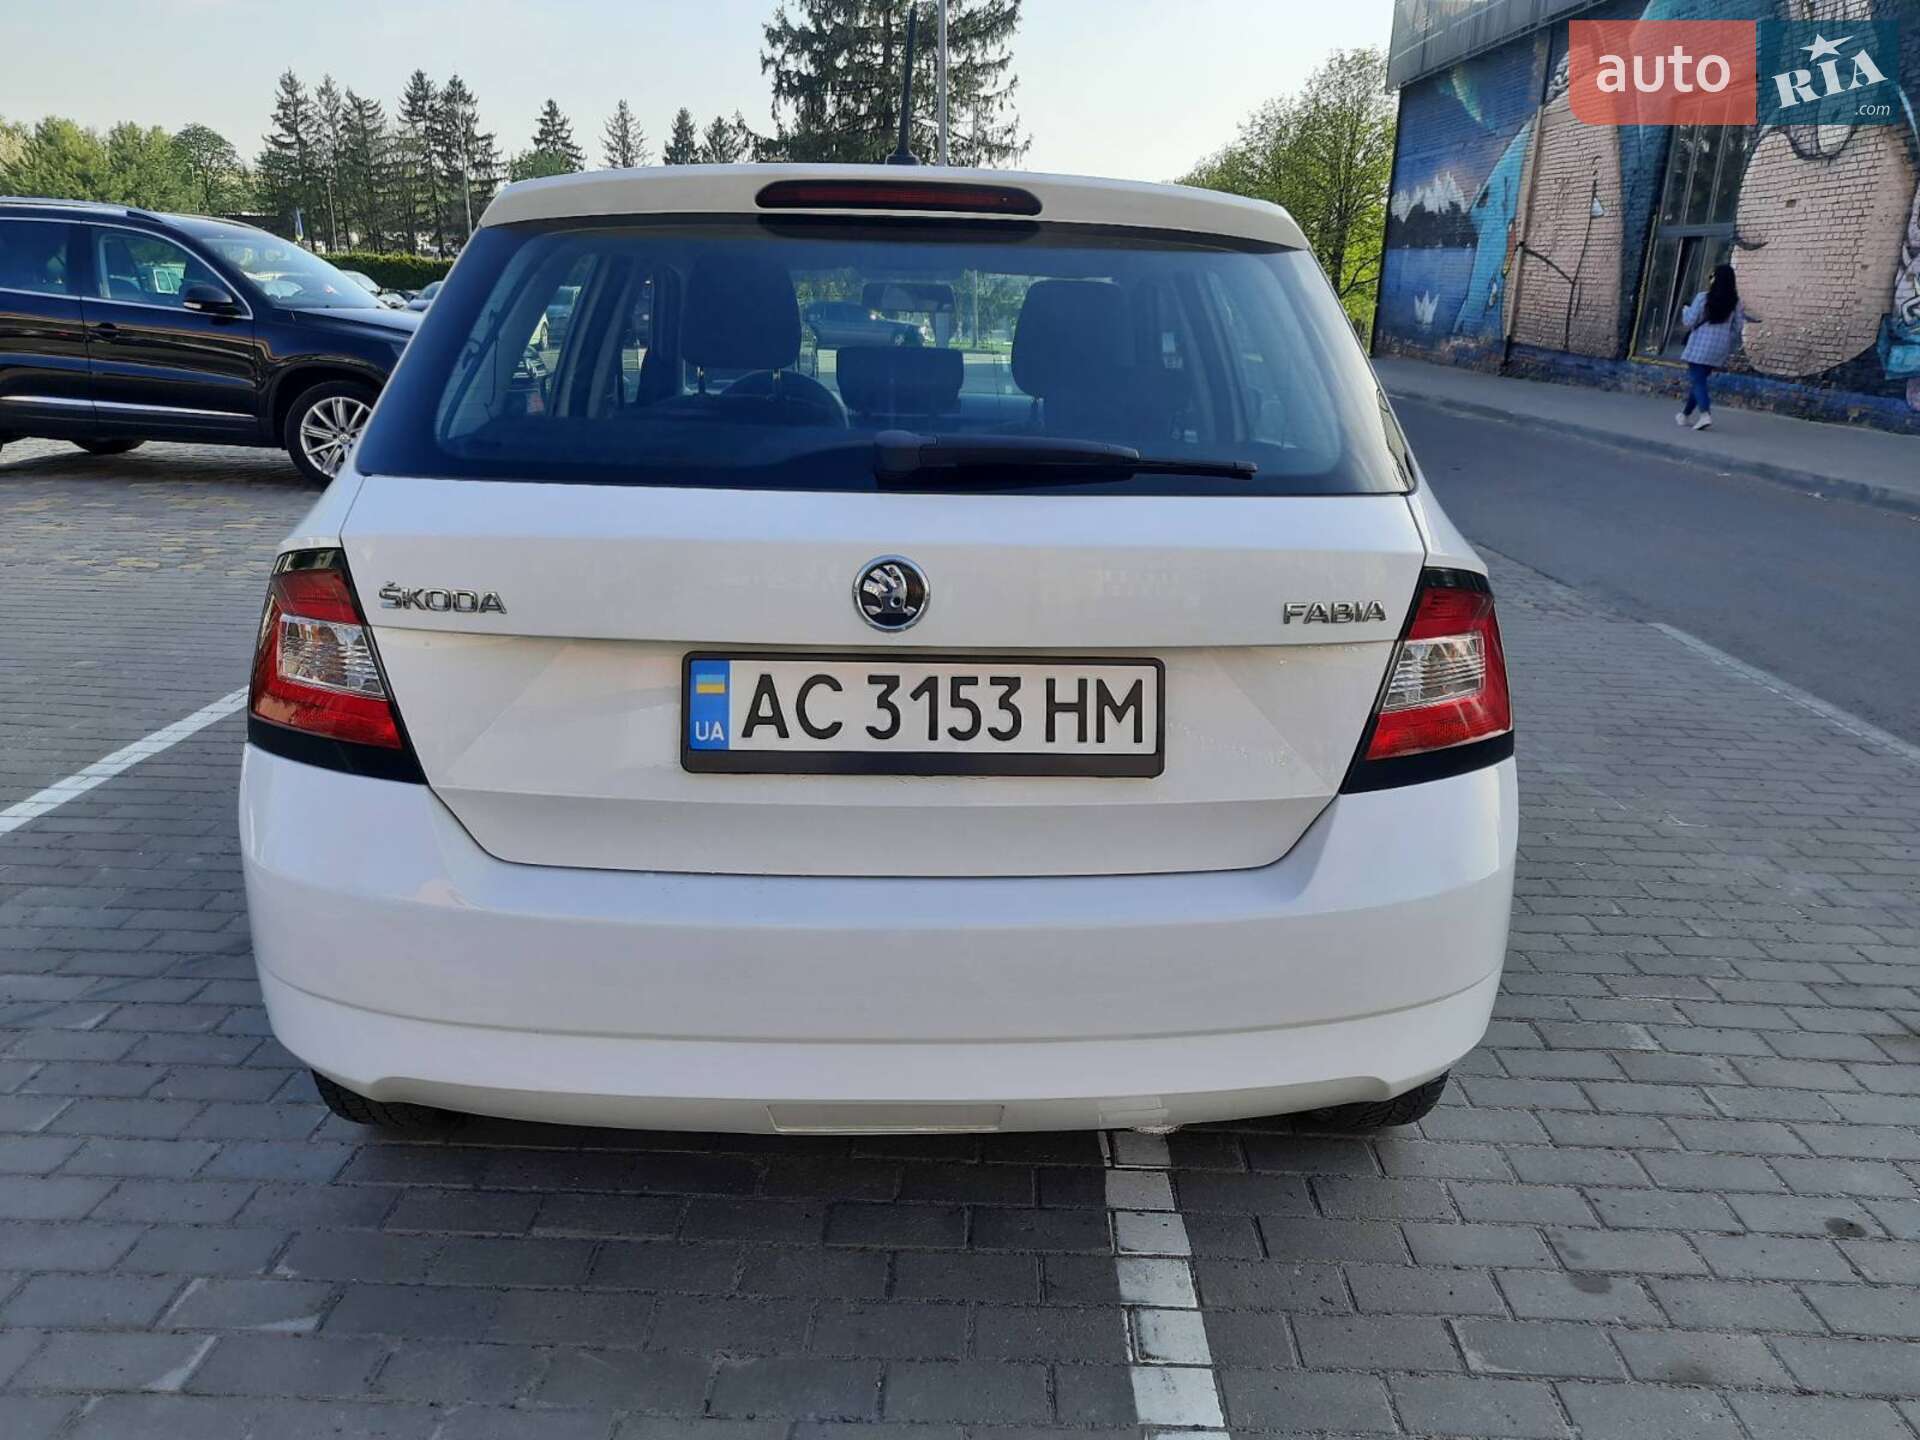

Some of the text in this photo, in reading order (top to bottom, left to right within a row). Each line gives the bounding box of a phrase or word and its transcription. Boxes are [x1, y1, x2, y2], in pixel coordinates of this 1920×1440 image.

[379, 580, 507, 615] ŠKODA
[1283, 600, 1387, 624] FABIA
[741, 673, 1144, 744] AC 3153 HM
[695, 721, 725, 742] UA
